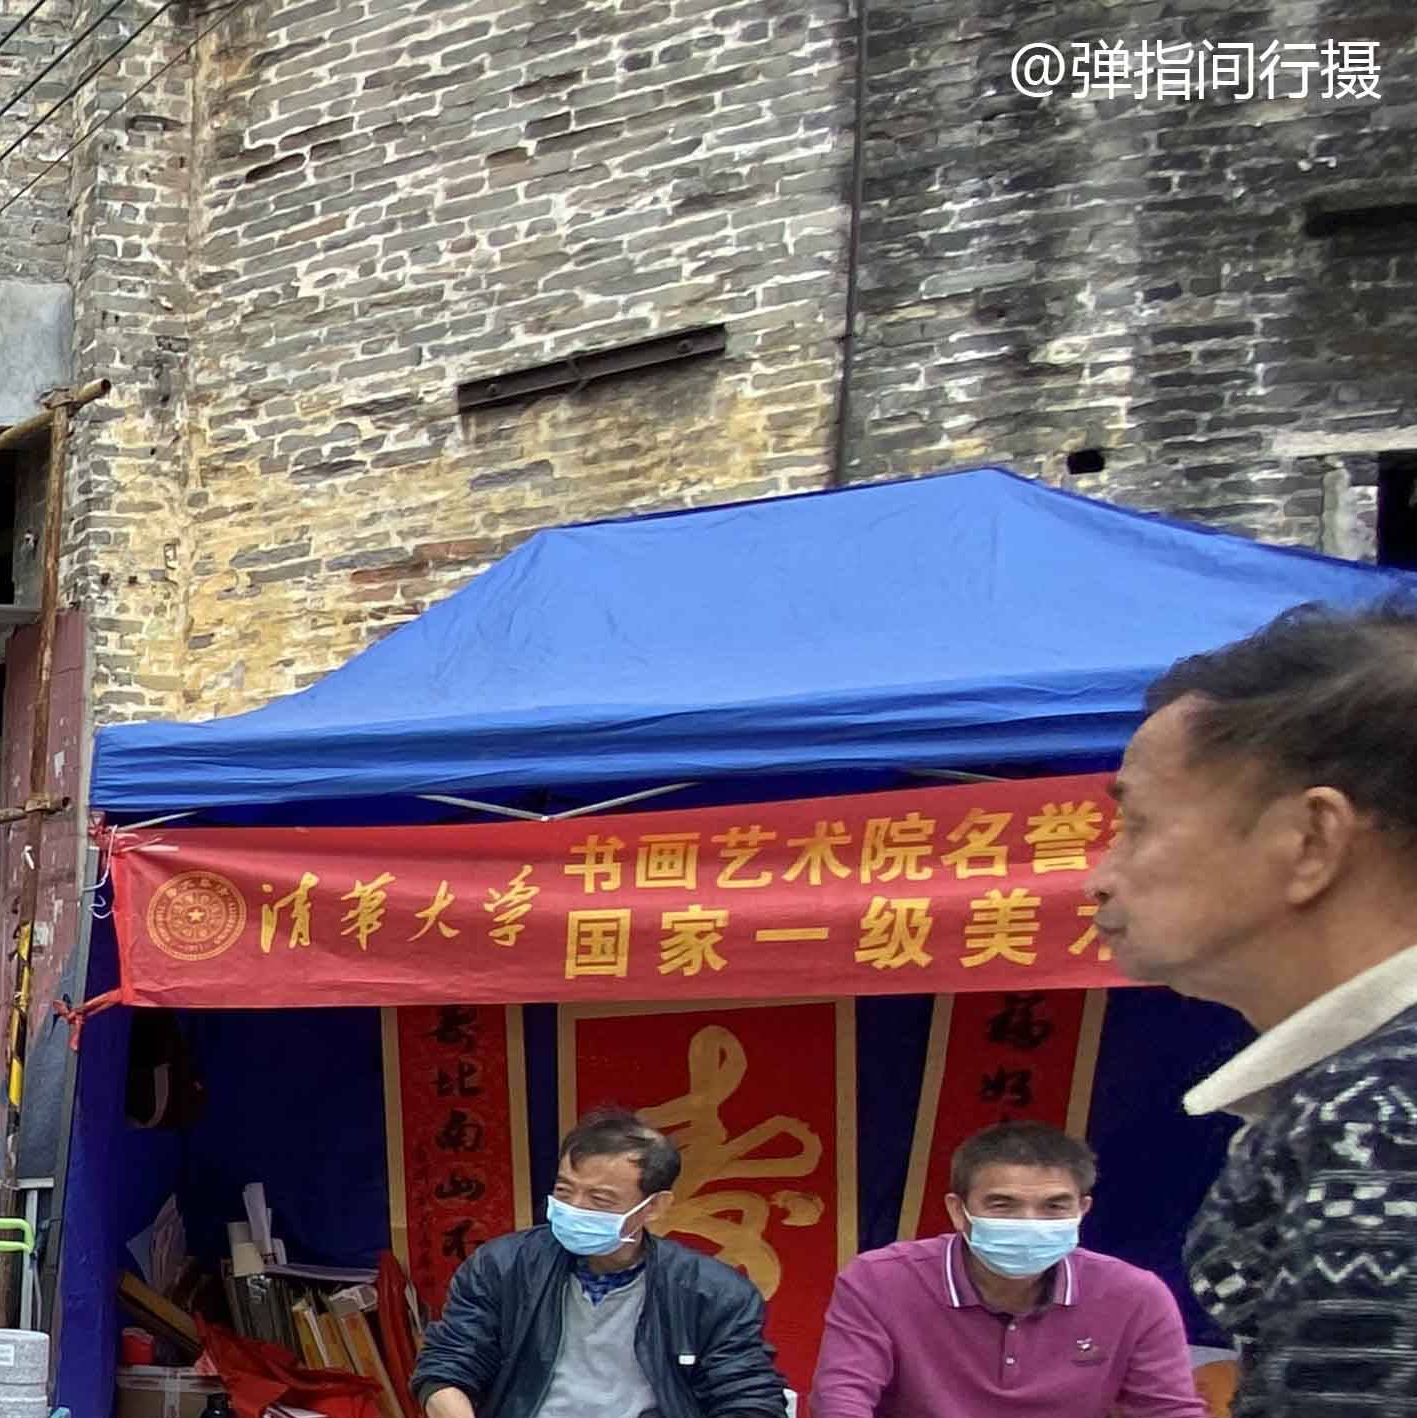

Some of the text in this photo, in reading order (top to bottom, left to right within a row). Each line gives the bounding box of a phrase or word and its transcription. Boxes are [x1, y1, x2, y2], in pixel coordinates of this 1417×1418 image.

[563, 800, 1119, 896] 书画艺术院名誉
